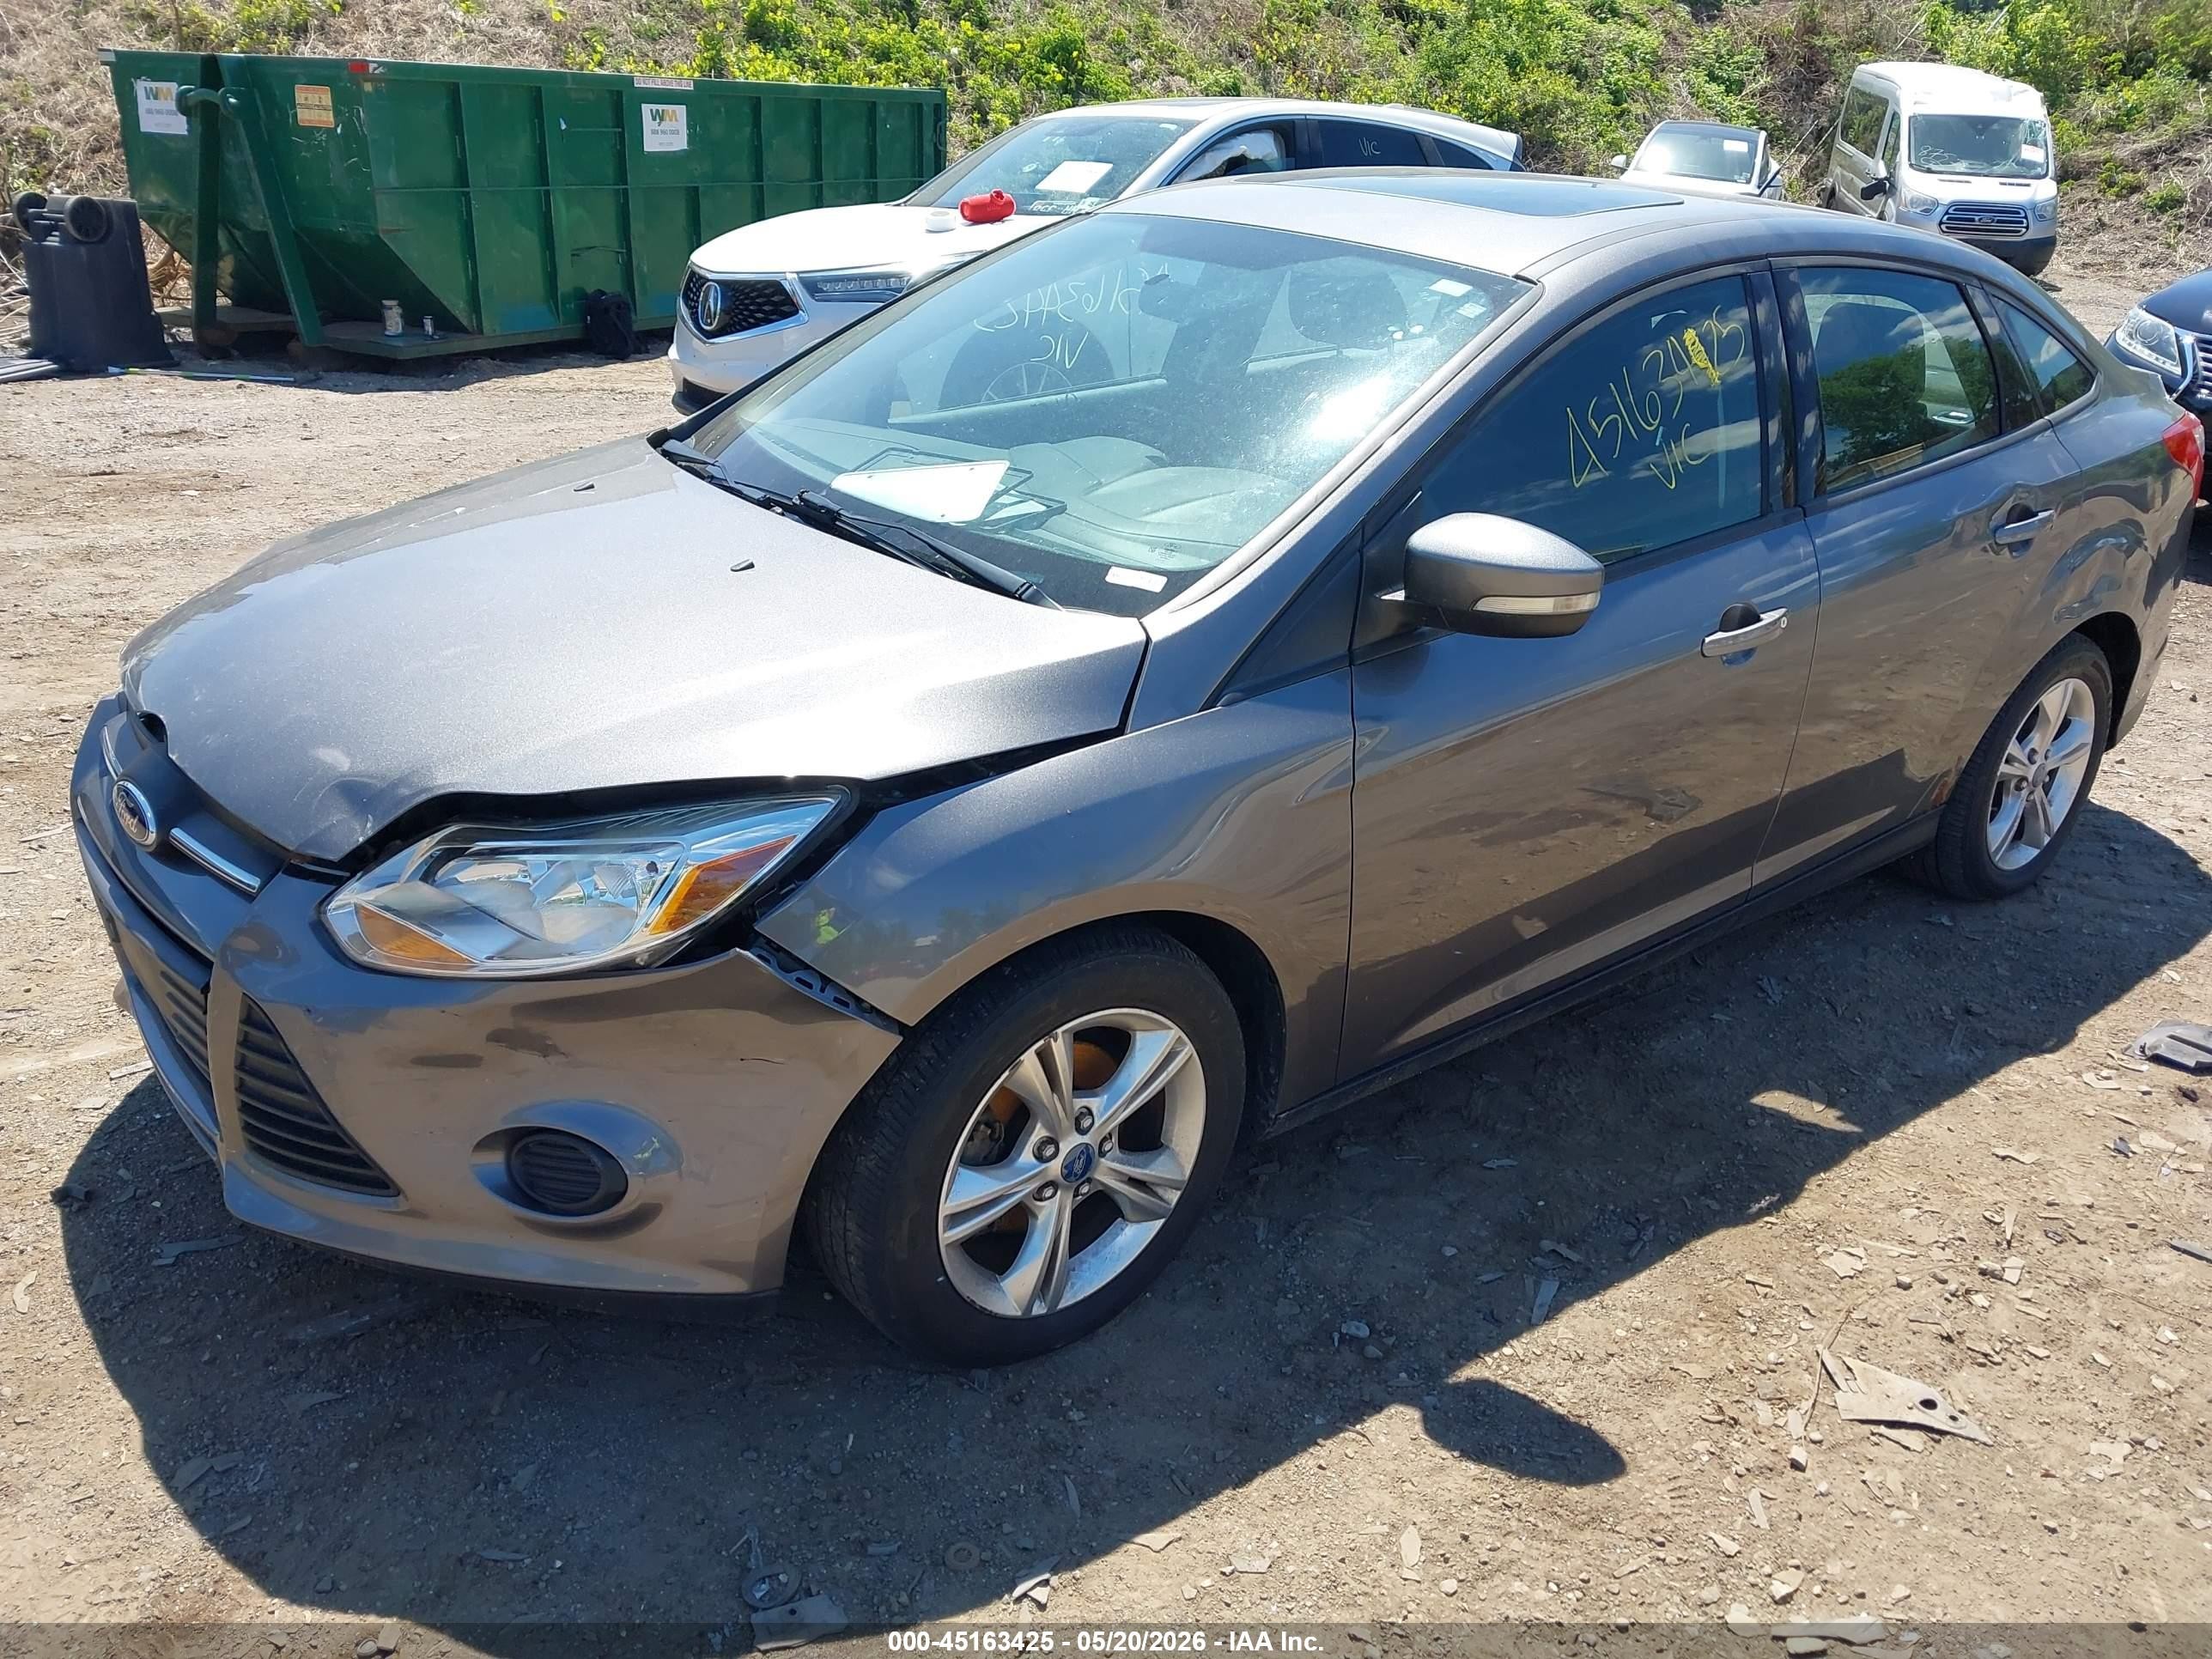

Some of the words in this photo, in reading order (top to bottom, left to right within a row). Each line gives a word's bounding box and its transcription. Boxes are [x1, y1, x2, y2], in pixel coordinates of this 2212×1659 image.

[143, 86, 174, 101] WM
[649, 108, 679, 126] WM
[1650, 422, 1711, 490] VIC
